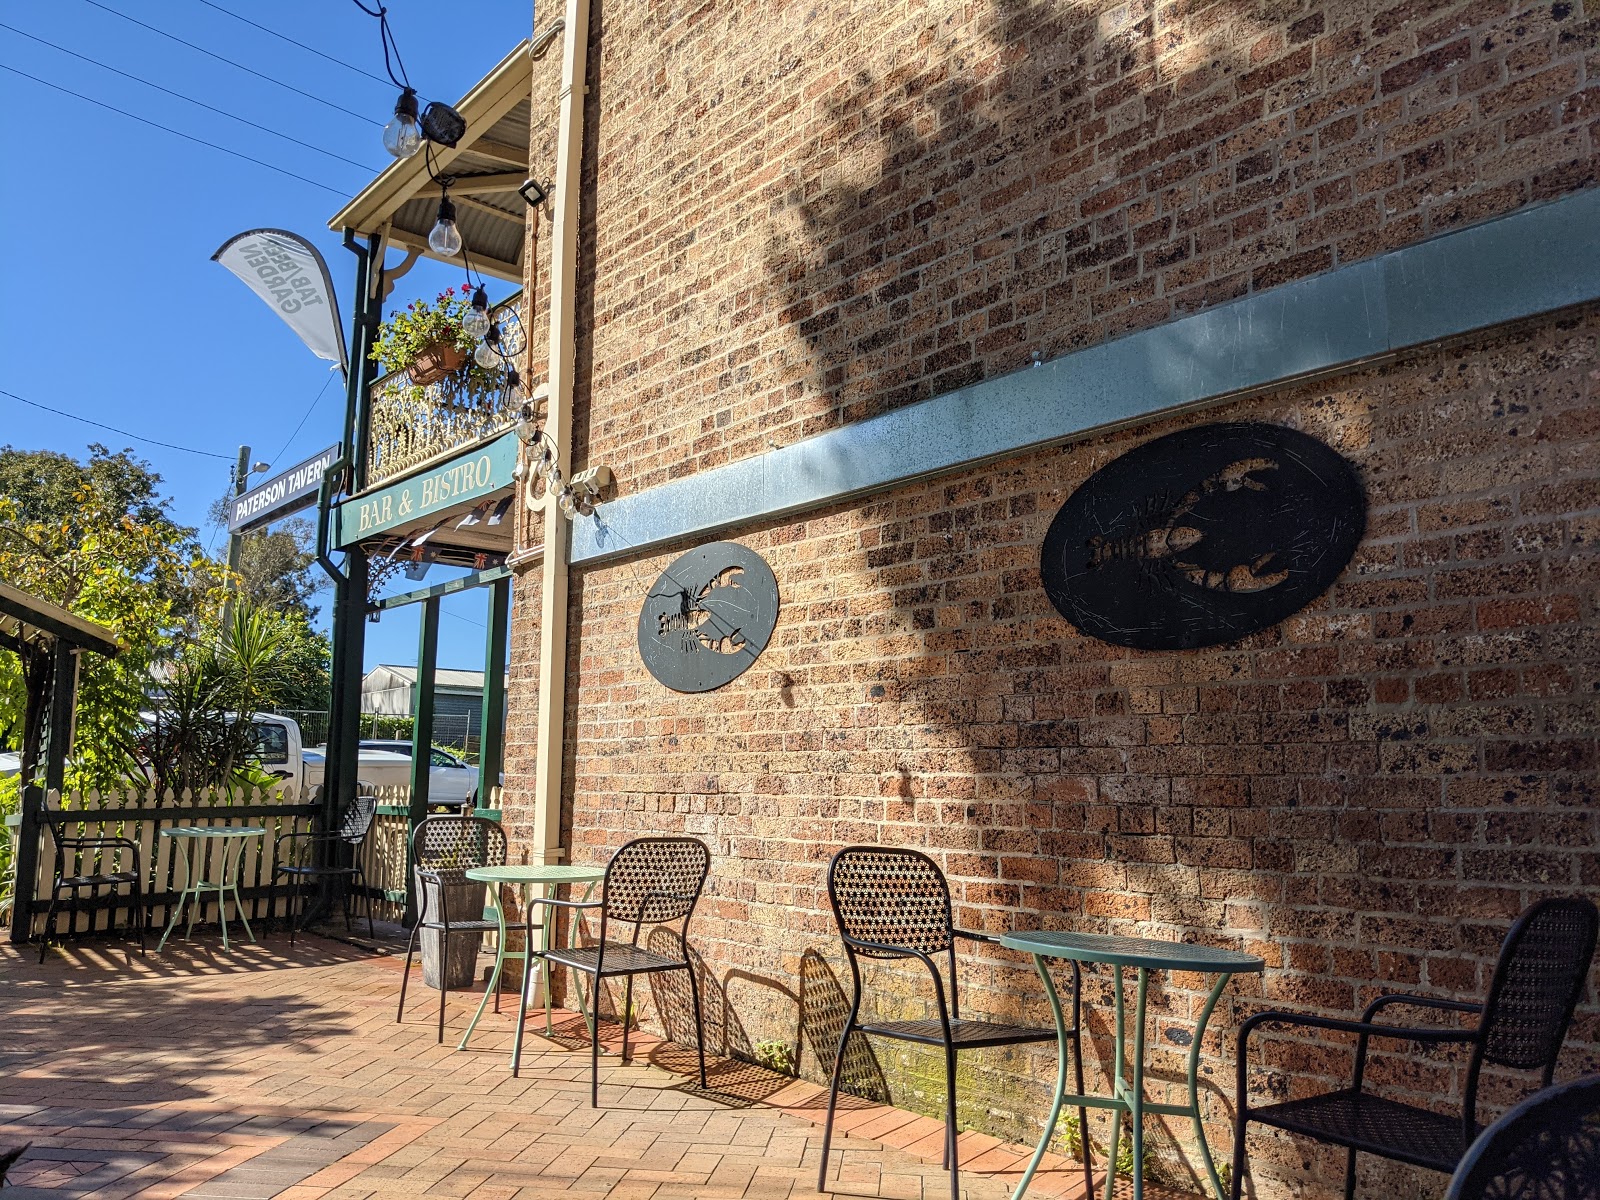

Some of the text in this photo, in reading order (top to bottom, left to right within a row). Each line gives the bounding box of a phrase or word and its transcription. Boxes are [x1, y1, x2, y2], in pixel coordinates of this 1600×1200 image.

[235, 455, 331, 521] PATERSON TAVERN
[358, 455, 491, 532] BAR & BISTRO
